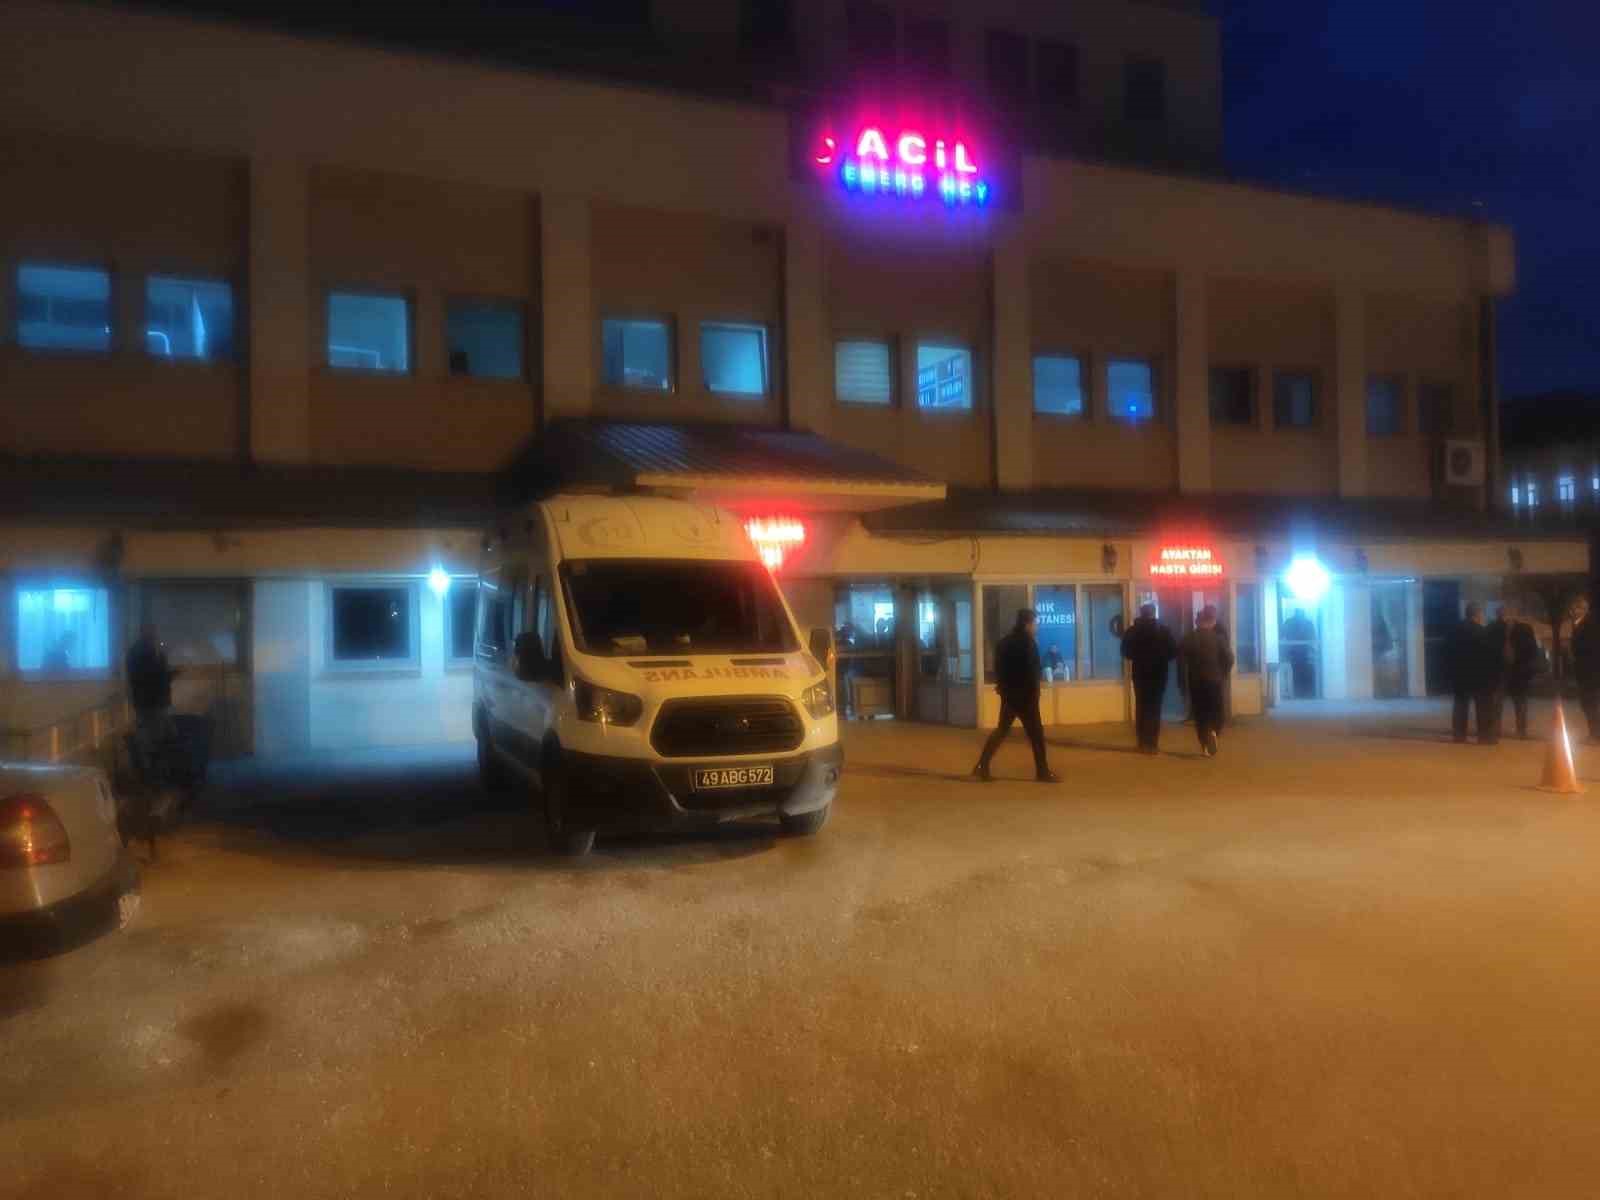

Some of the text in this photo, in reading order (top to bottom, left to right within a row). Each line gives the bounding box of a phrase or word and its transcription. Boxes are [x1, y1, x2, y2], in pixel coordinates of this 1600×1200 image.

[703, 768, 771, 785] 49 ABG 572
